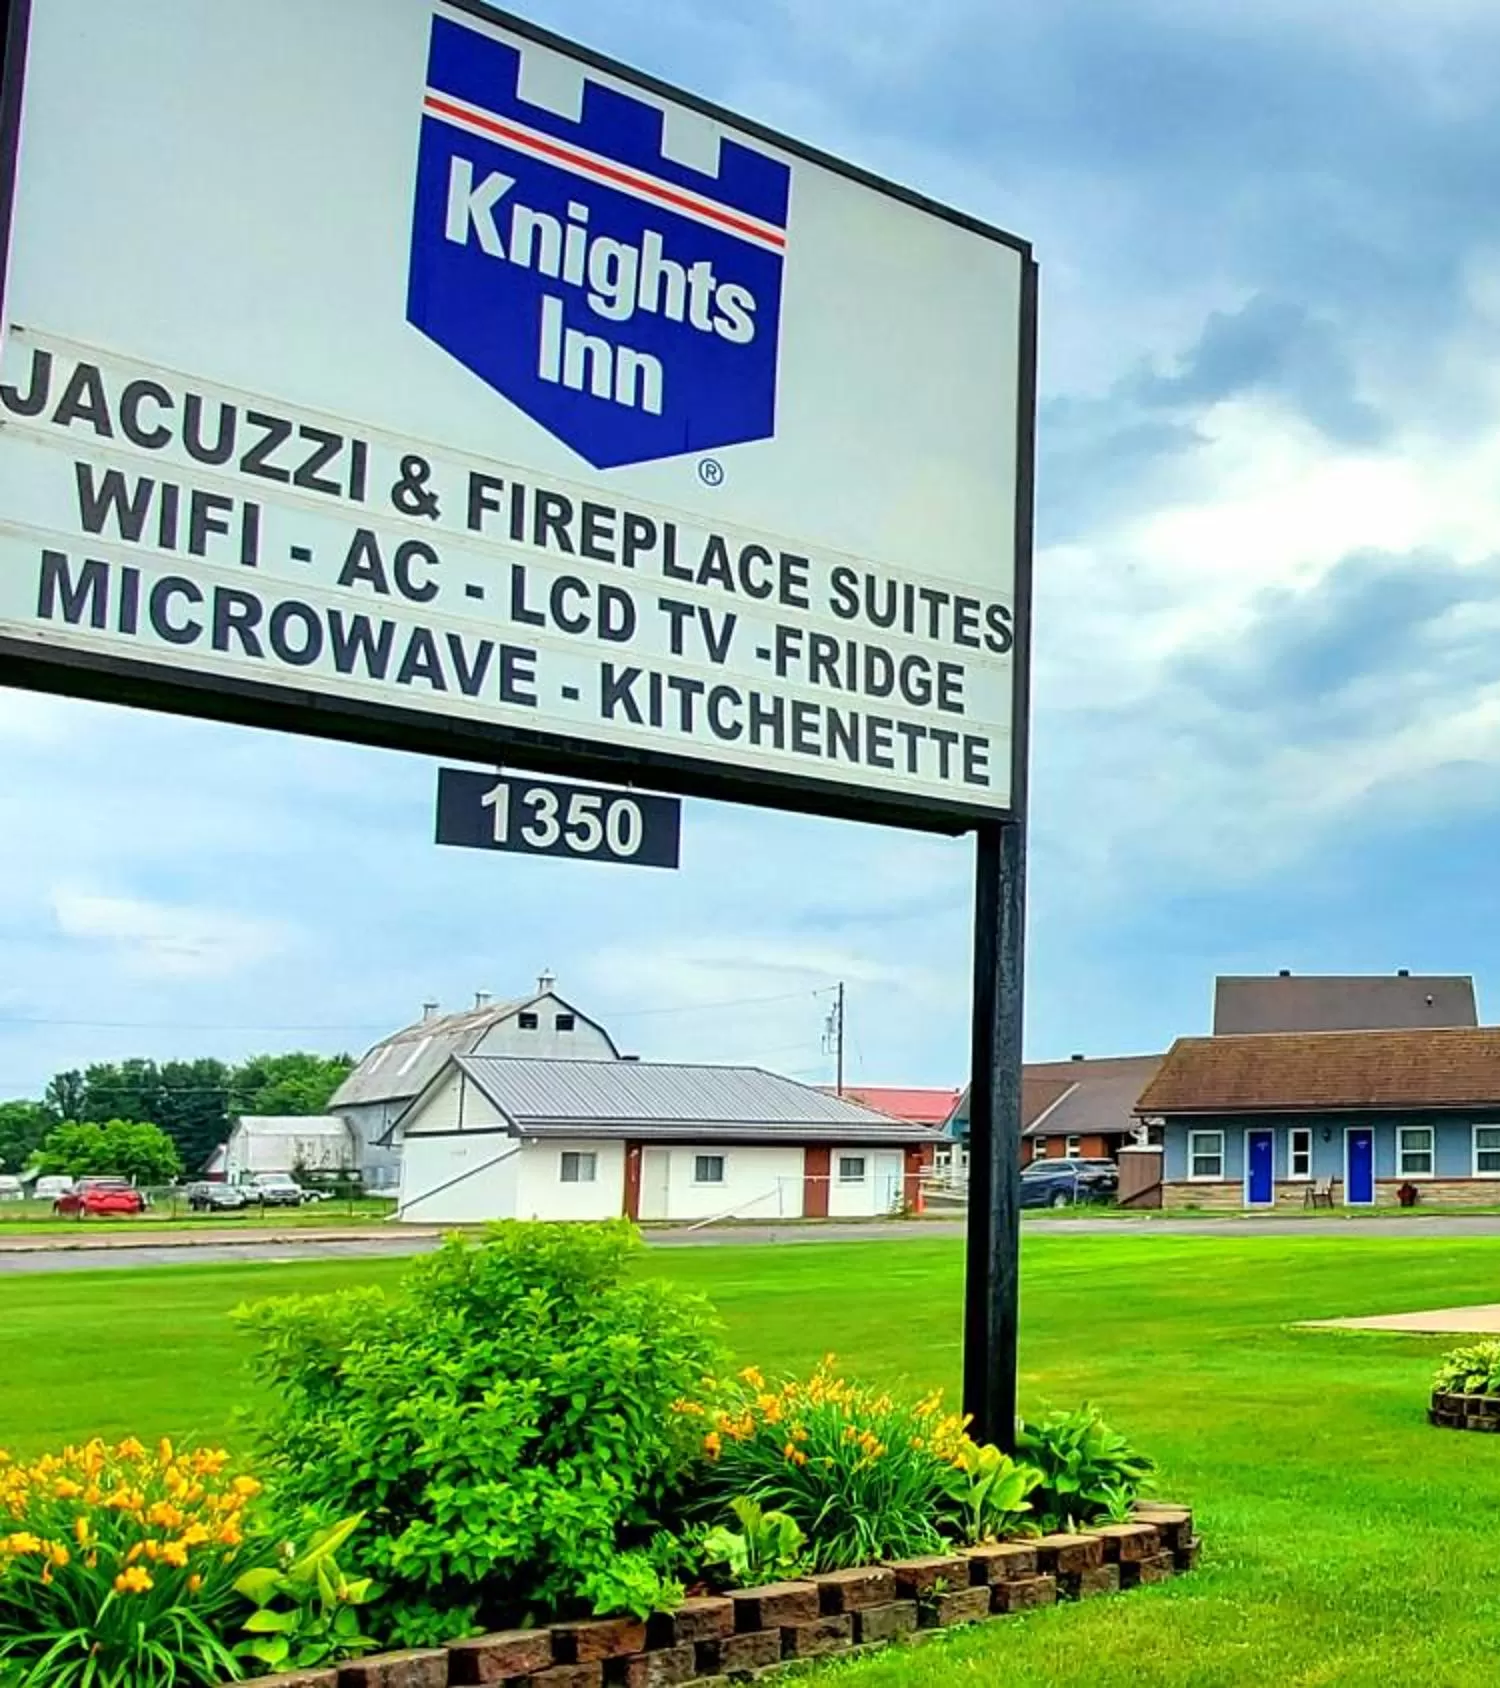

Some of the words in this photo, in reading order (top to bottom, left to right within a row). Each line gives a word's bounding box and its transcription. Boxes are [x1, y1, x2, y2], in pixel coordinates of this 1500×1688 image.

[445, 156, 757, 344] Knights
[540, 294, 663, 415] Inn
[0, 349, 367, 502] JACUZZI
[391, 455, 440, 521] &
[466, 472, 808, 610] FIREPLACE
[829, 567, 1013, 654] SUITES
[75, 461, 260, 568] WIFI
[337, 527, 439, 603] AC
[510, 563, 637, 643] LCD
[659, 598, 737, 666] TV
[37, 549, 537, 708] MICROWAVE
[601, 661, 990, 787] KITCHENETTE
[481, 783, 644, 857] 1350
